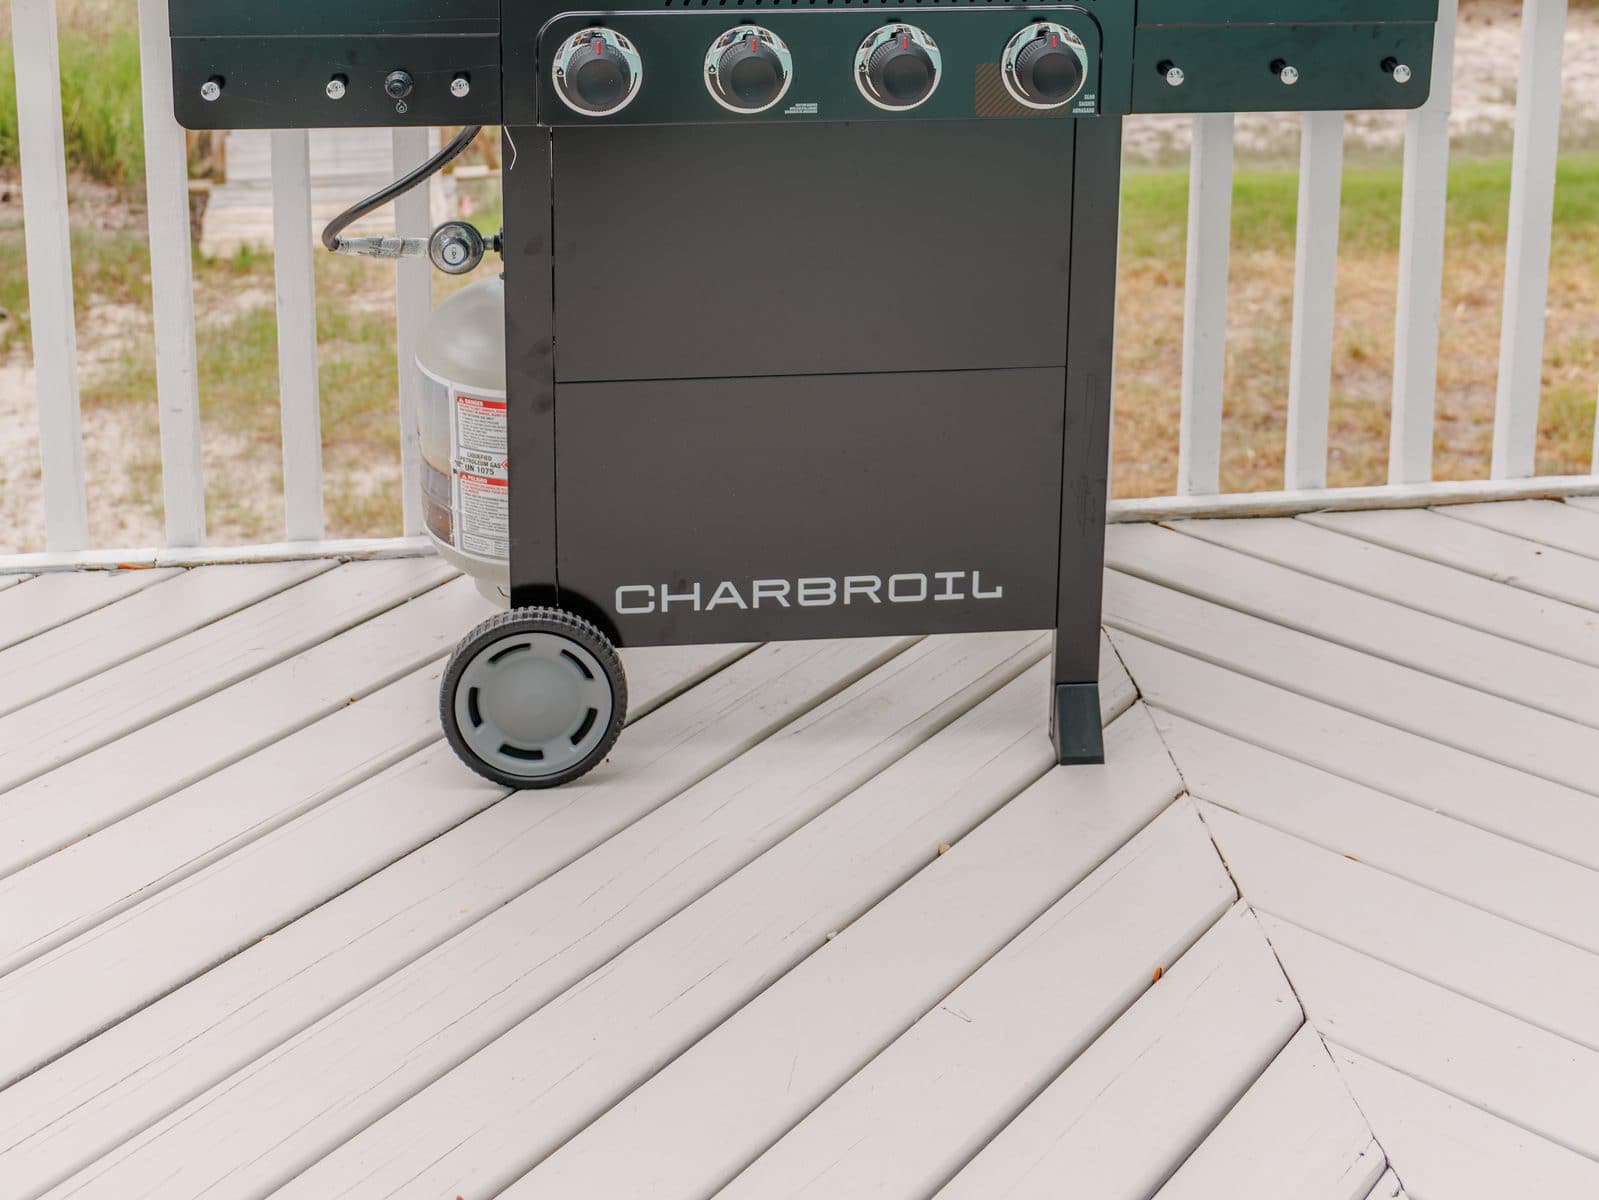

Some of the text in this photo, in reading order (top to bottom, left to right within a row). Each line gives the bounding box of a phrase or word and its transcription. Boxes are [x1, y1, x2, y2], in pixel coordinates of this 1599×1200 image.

[460, 456, 502, 469] PETROLEUM GAS
[467, 452, 493, 461] LIQUEFIED
[465, 464, 495, 476] UN 1075
[615, 571, 1002, 614] CHARBROIL
